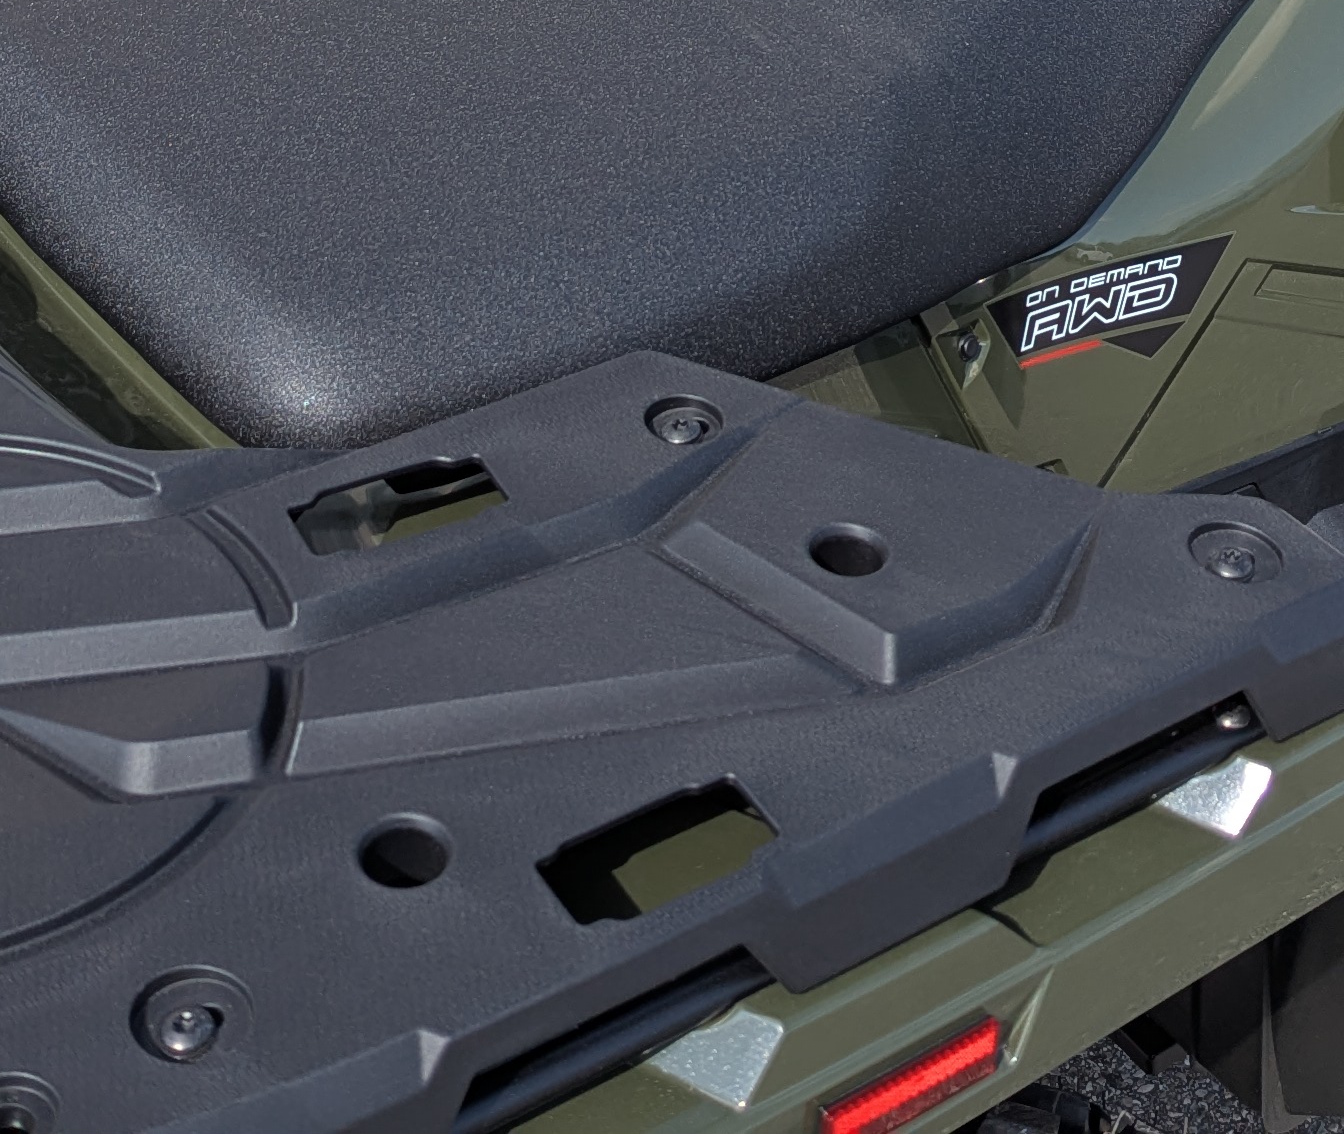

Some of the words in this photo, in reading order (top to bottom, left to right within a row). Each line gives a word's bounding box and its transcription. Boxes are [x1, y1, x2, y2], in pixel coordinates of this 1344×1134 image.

[1020, 272, 1178, 353] AWD
[1026, 285, 1060, 308] ON
[1070, 254, 1183, 293] DEMAND
